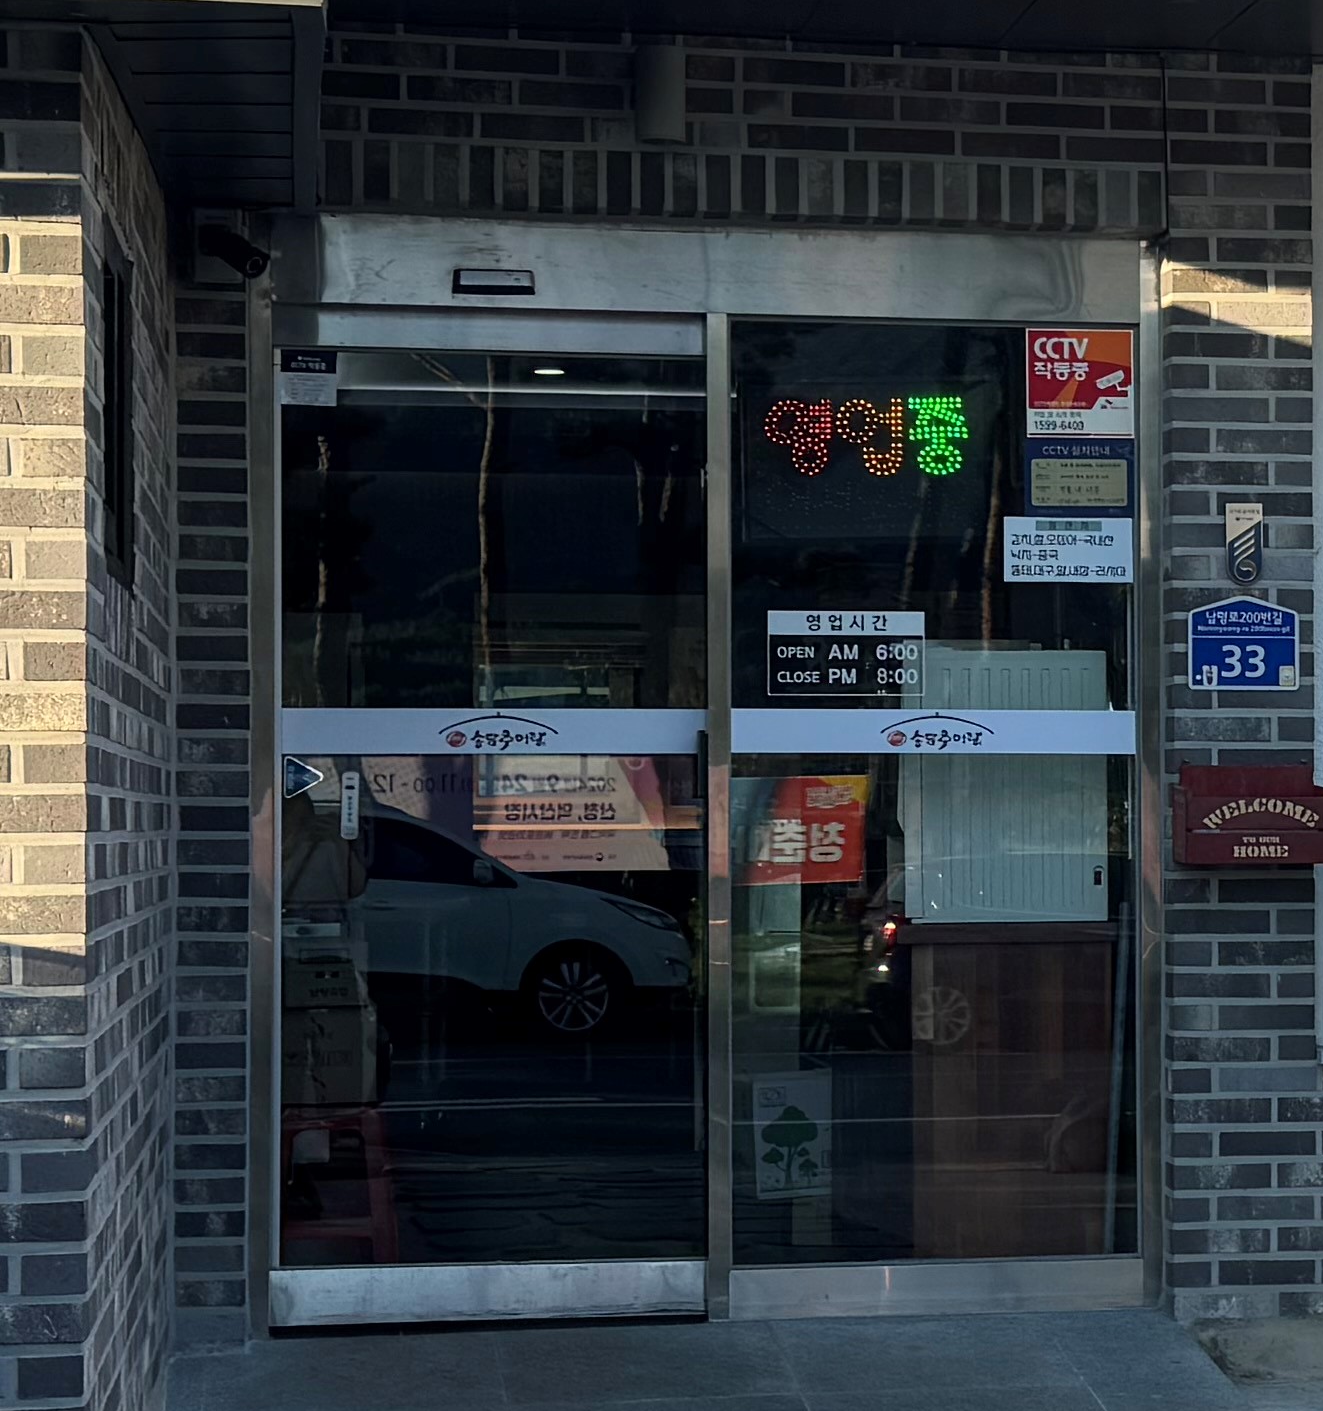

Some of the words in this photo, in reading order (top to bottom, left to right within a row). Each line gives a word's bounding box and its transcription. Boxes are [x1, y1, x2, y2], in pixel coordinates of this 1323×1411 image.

[1034, 337, 1089, 359] CCTV
[1034, 361, 1090, 381] 작동중
[764, 396, 969, 477] 영업중
[1042, 445, 1069, 455] CCTV
[806, 613, 888, 632] 영업시간
[777, 646, 815, 659] OPEN
[828, 644, 859, 661] AM
[876, 644, 919, 661] 6:00
[1221, 644, 1266, 679] 33
[777, 671, 821, 684] CLOSE
[828, 668, 857, 685] PM
[877, 668, 919, 685] 8:00
[1202, 797, 1320, 829] WELCOME
[1233, 845, 1289, 858] HOME
